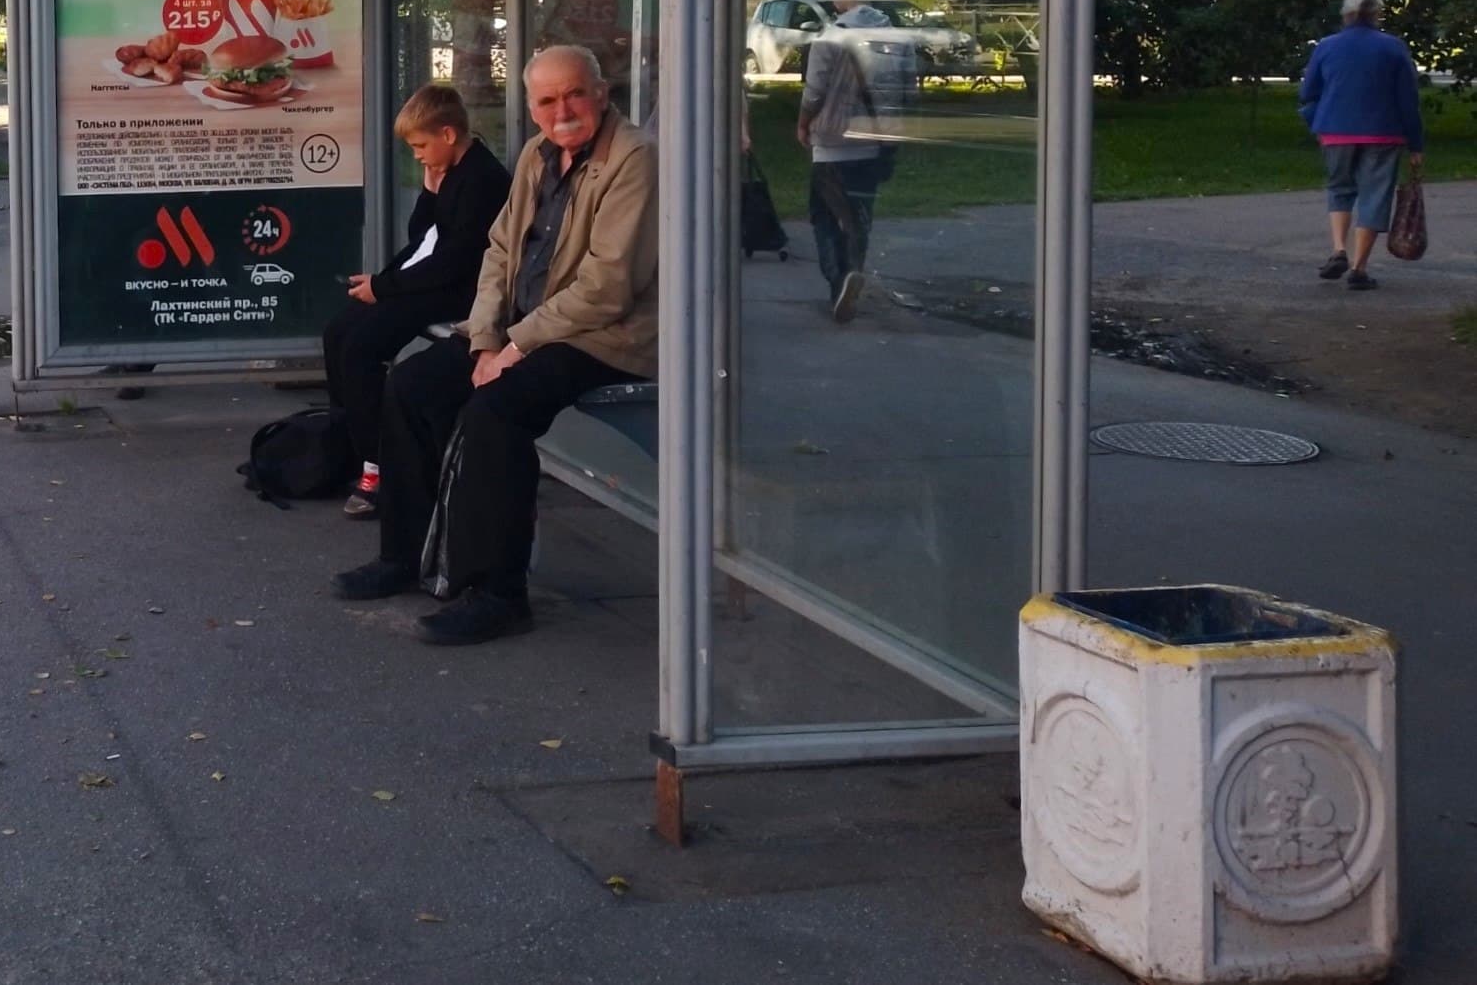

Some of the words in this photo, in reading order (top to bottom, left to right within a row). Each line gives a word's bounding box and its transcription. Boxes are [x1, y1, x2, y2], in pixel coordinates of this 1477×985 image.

[76, 119, 117, 129] Только
[130, 118, 204, 129] приложении
[307, 138, 336, 164] 12+
[125, 280, 169, 290] ВКУСНО
[180, 279, 189, 287] И
[191, 278, 228, 287] ТОЧКА
[150, 297, 231, 311] Лахтинский
